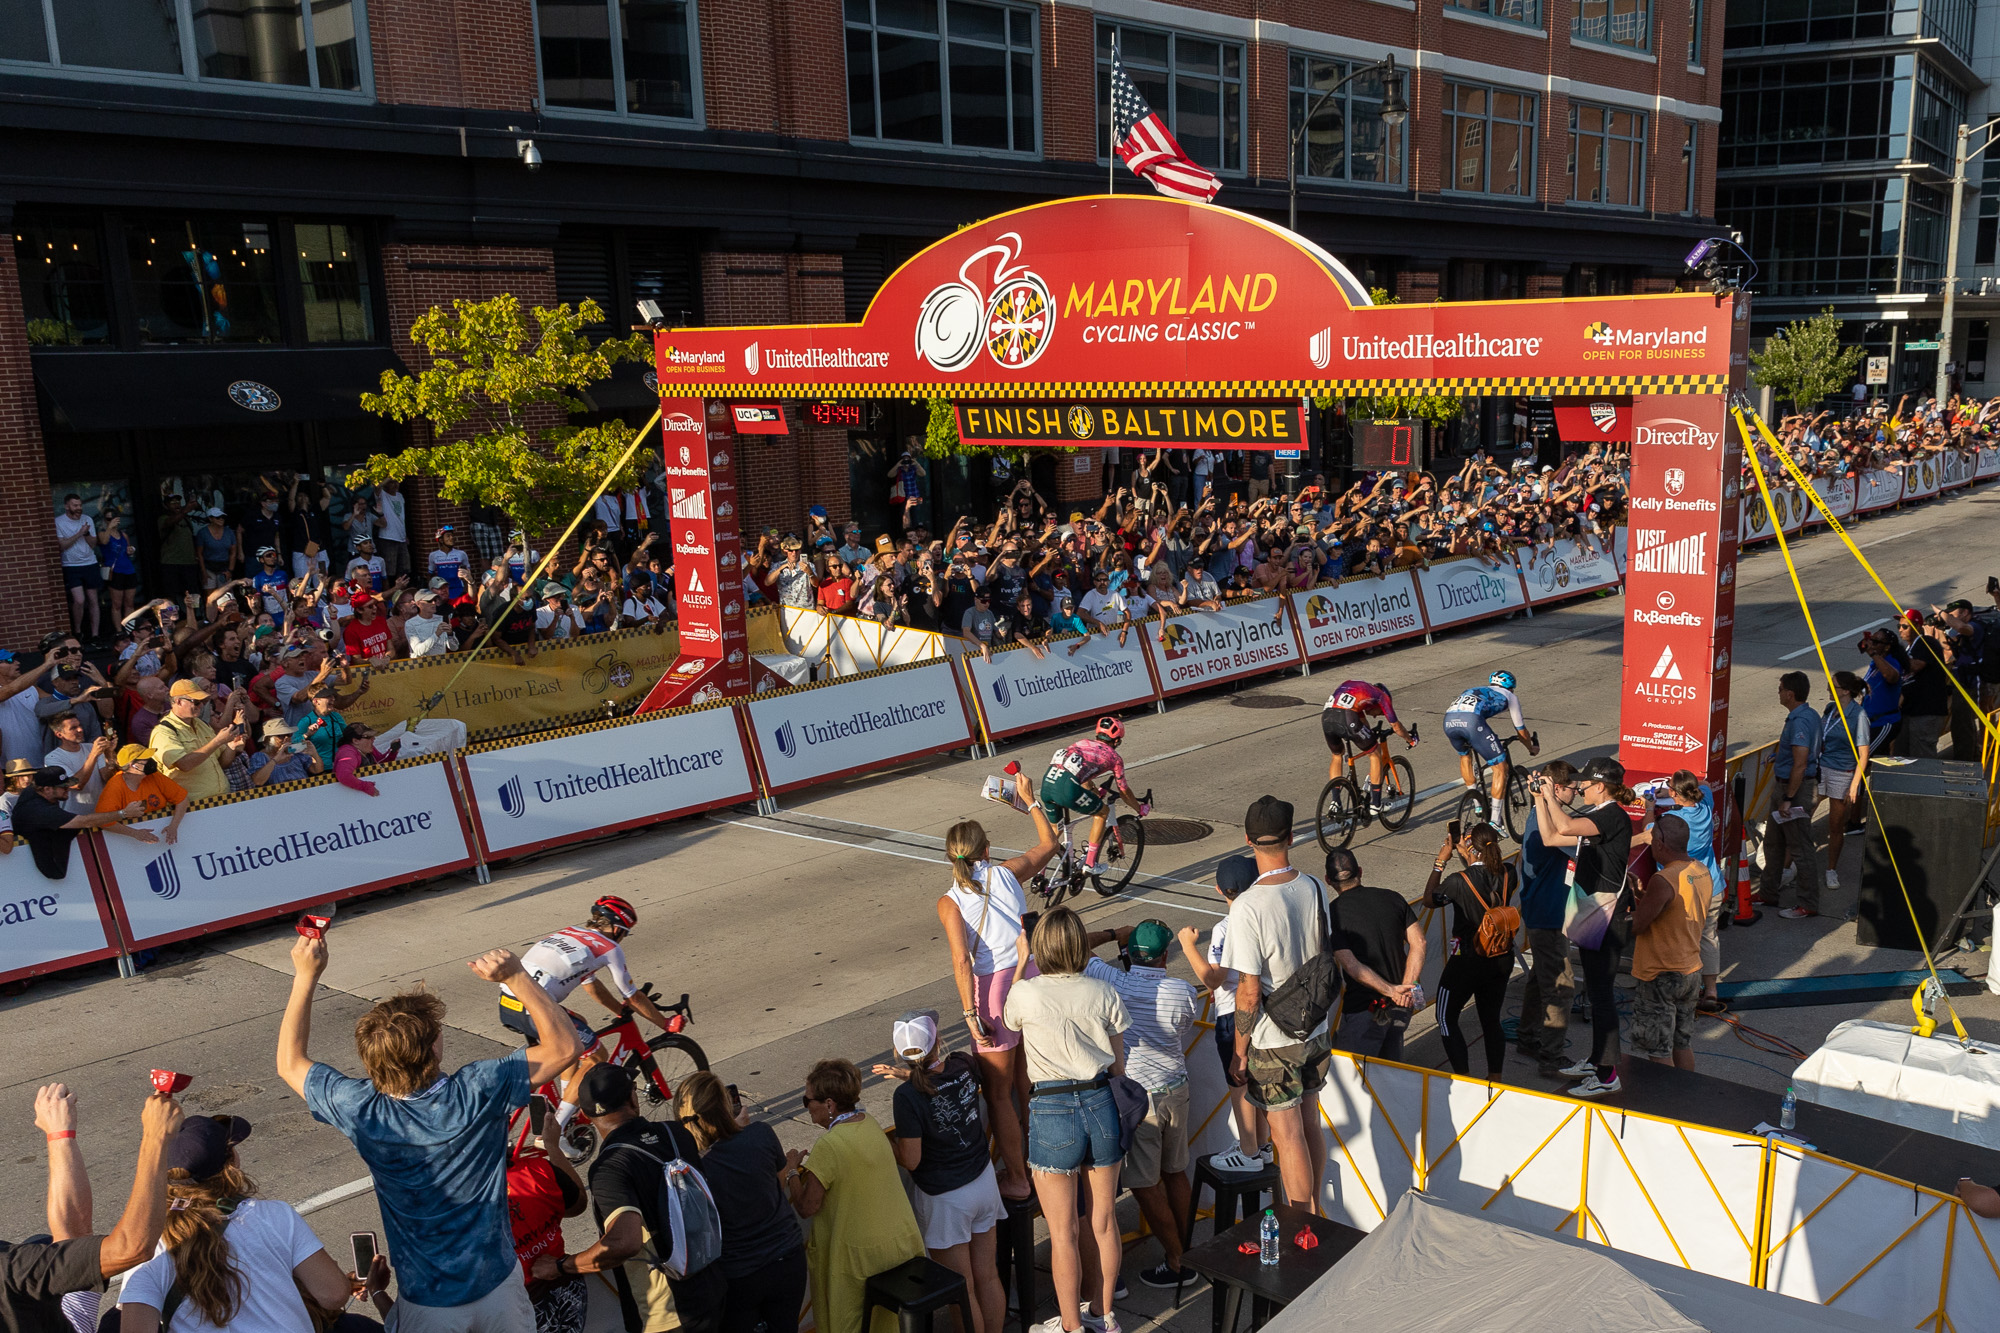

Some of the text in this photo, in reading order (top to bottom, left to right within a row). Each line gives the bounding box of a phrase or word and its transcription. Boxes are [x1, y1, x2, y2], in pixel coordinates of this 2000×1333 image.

[1692, 245, 1705, 260] LYNX
[1064, 272, 1278, 319] MARYLAND
[1082, 323, 1159, 343] CYCLING
[1615, 326, 1707, 348] Maryland
[681, 350, 726, 365] Maryland
[1583, 348, 1706, 361] OPEN FOR BUSINESS
[696, 365, 726, 373] BUSINESS
[737, 410, 753, 420] UCI
[1591, 403, 1612, 411] USA
[663, 418, 703, 435] DirectPay
[967, 408, 1062, 436] FINISH
[1103, 408, 1289, 438] BALTIMORE
[1636, 426, 1720, 450] DirectPay
[1278, 448, 1296, 457] HERE
[667, 466, 682, 477] Kelly
[682, 467, 708, 477] Benefits
[671, 488, 686, 503] VISIT
[672, 491, 708, 519] BALTIMORE
[1632, 497, 1717, 512] Kelly Benefits
[1821, 508, 1844, 534] KEEPER
[1635, 528, 1667, 553] VISIT
[1634, 531, 1708, 575] BALTIMORE
[682, 593, 713, 606] ALLEGIS
[1437, 573, 1507, 611] DirectPay
[1336, 590, 1411, 624] Maryland
[1633, 609, 1703, 627] RxBenefits
[1195, 618, 1284, 654] Maryland
[1313, 613, 1416, 648] OPEN FOR BUSINESS
[363, 632, 388, 647] PRETEND
[1170, 643, 1290, 682] OPEN FOR BUSINESS
[454, 677, 565, 709] Harbor East
[1635, 681, 1697, 700] ALLEGIS
[341, 697, 395, 714] ARYLAND
[1341, 694, 1354, 705] 47
[1462, 696, 1476, 707] 22
[1647, 697, 1683, 705] GROUP
[1647, 722, 1677, 731] Production
[1622, 735, 1684, 747] ENTERTAINMENT
[1653, 732, 1678, 740] SPORT
[1046, 766, 1065, 780] EF
[1075, 793, 1093, 807] EF
[558, 967, 590, 986] TREK
